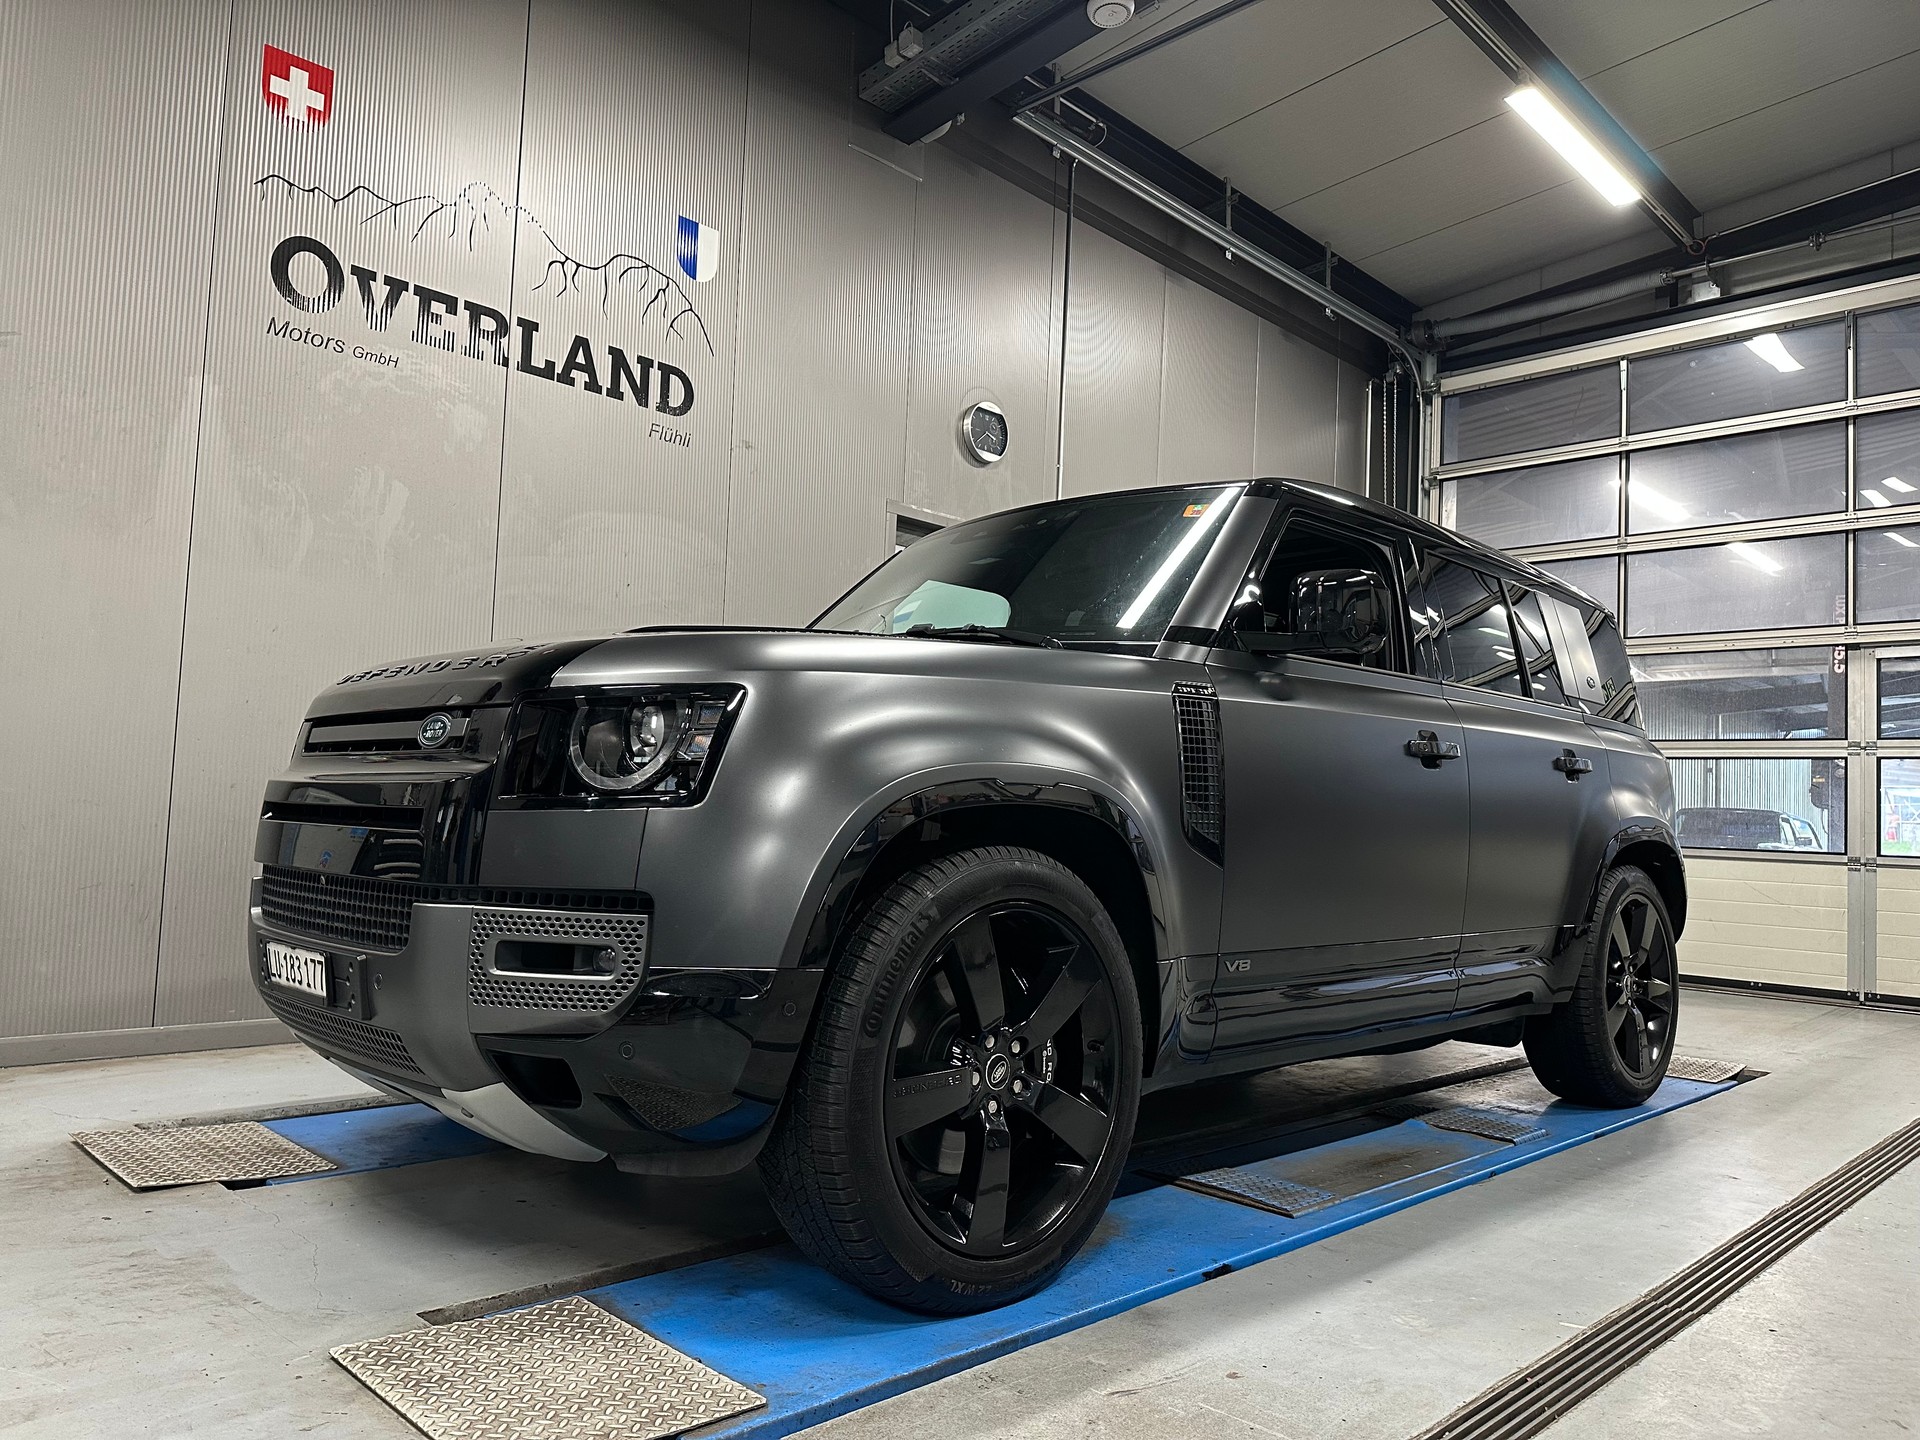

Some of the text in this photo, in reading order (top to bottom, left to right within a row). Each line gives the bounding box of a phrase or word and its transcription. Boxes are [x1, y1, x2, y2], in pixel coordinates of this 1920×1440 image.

[266, 316, 400, 369] Motors GmbH
[270, 235, 695, 417] OVERLAND
[648, 422, 692, 448] Flühli
[335, 653, 508, 686] DEFENDER
[862, 922, 924, 1038] Continental
[1224, 959, 1251, 973] V8
